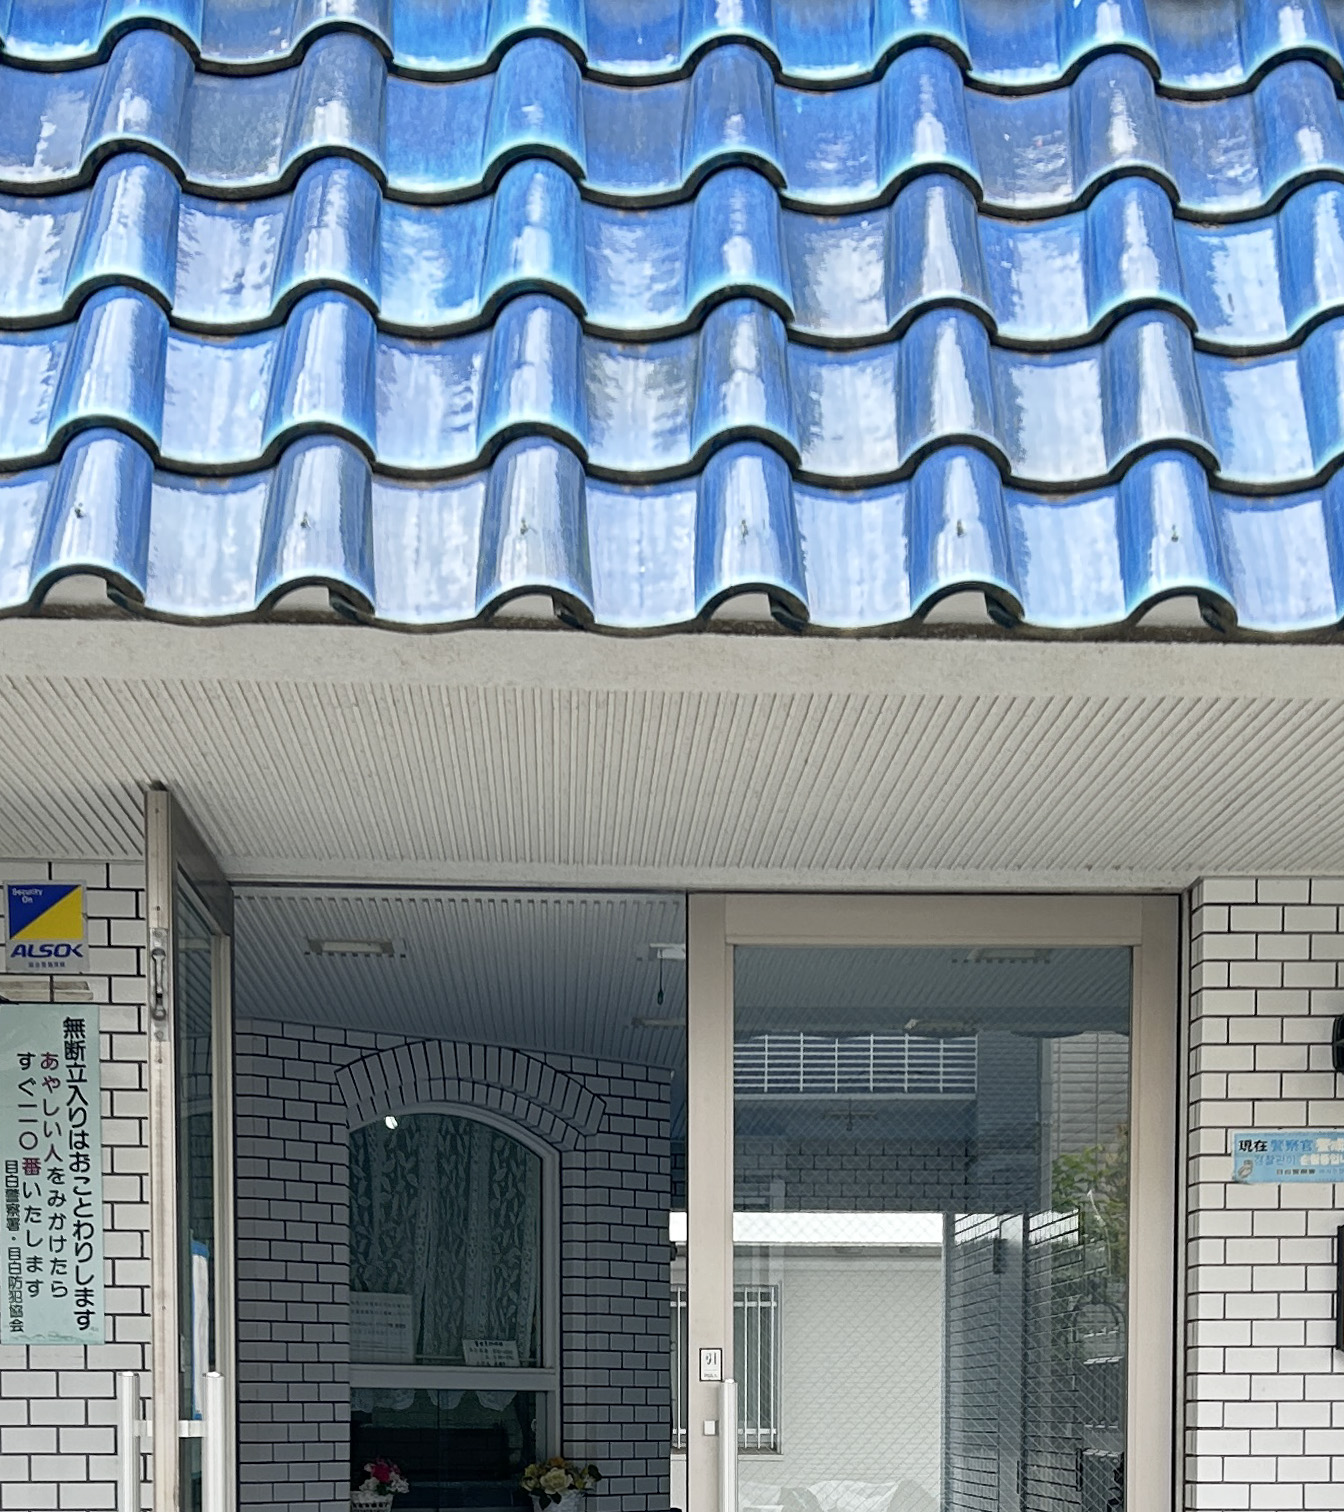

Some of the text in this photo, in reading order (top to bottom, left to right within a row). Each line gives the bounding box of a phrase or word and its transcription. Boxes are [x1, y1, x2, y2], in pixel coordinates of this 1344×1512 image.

[10, 943, 83, 958] ALSOK
[40, 1051, 68, 1298] あやしい人をみかけたら
[62, 1016, 95, 1331] 無断立入りはおことわりします
